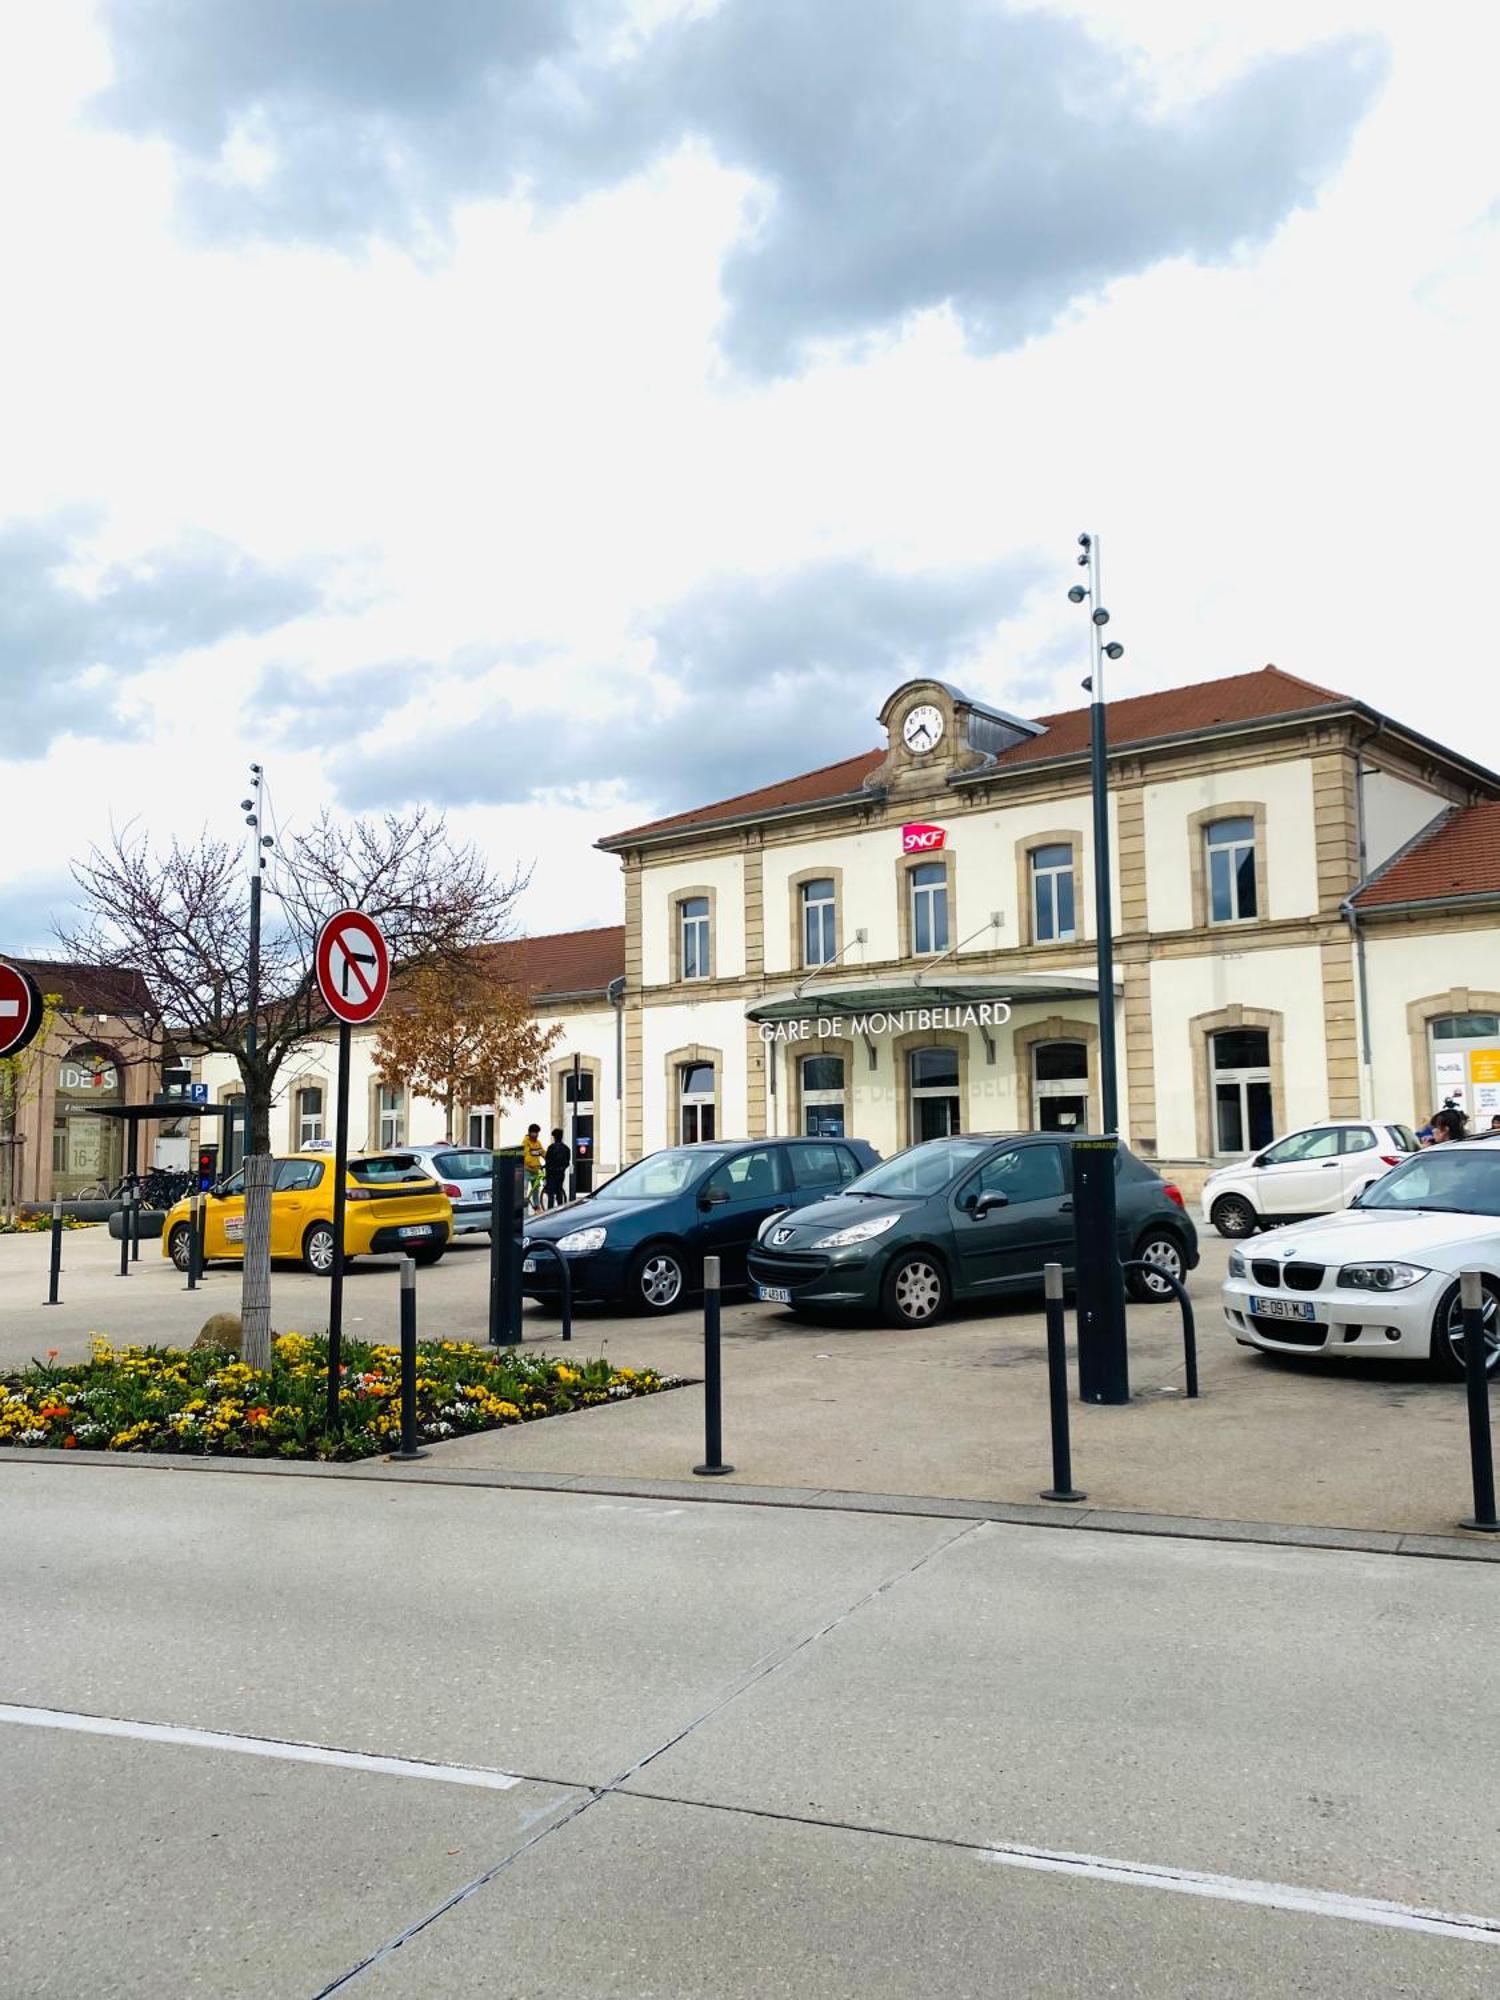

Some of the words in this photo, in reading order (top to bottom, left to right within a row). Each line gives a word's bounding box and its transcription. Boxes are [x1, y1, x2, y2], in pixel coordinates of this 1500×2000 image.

[904, 830, 944, 849] SNCF
[759, 1018, 810, 1042] GARE
[817, 1016, 843, 1039] DE
[851, 1002, 1012, 1035] MONTBELIARD
[195, 1084, 204, 1098] P
